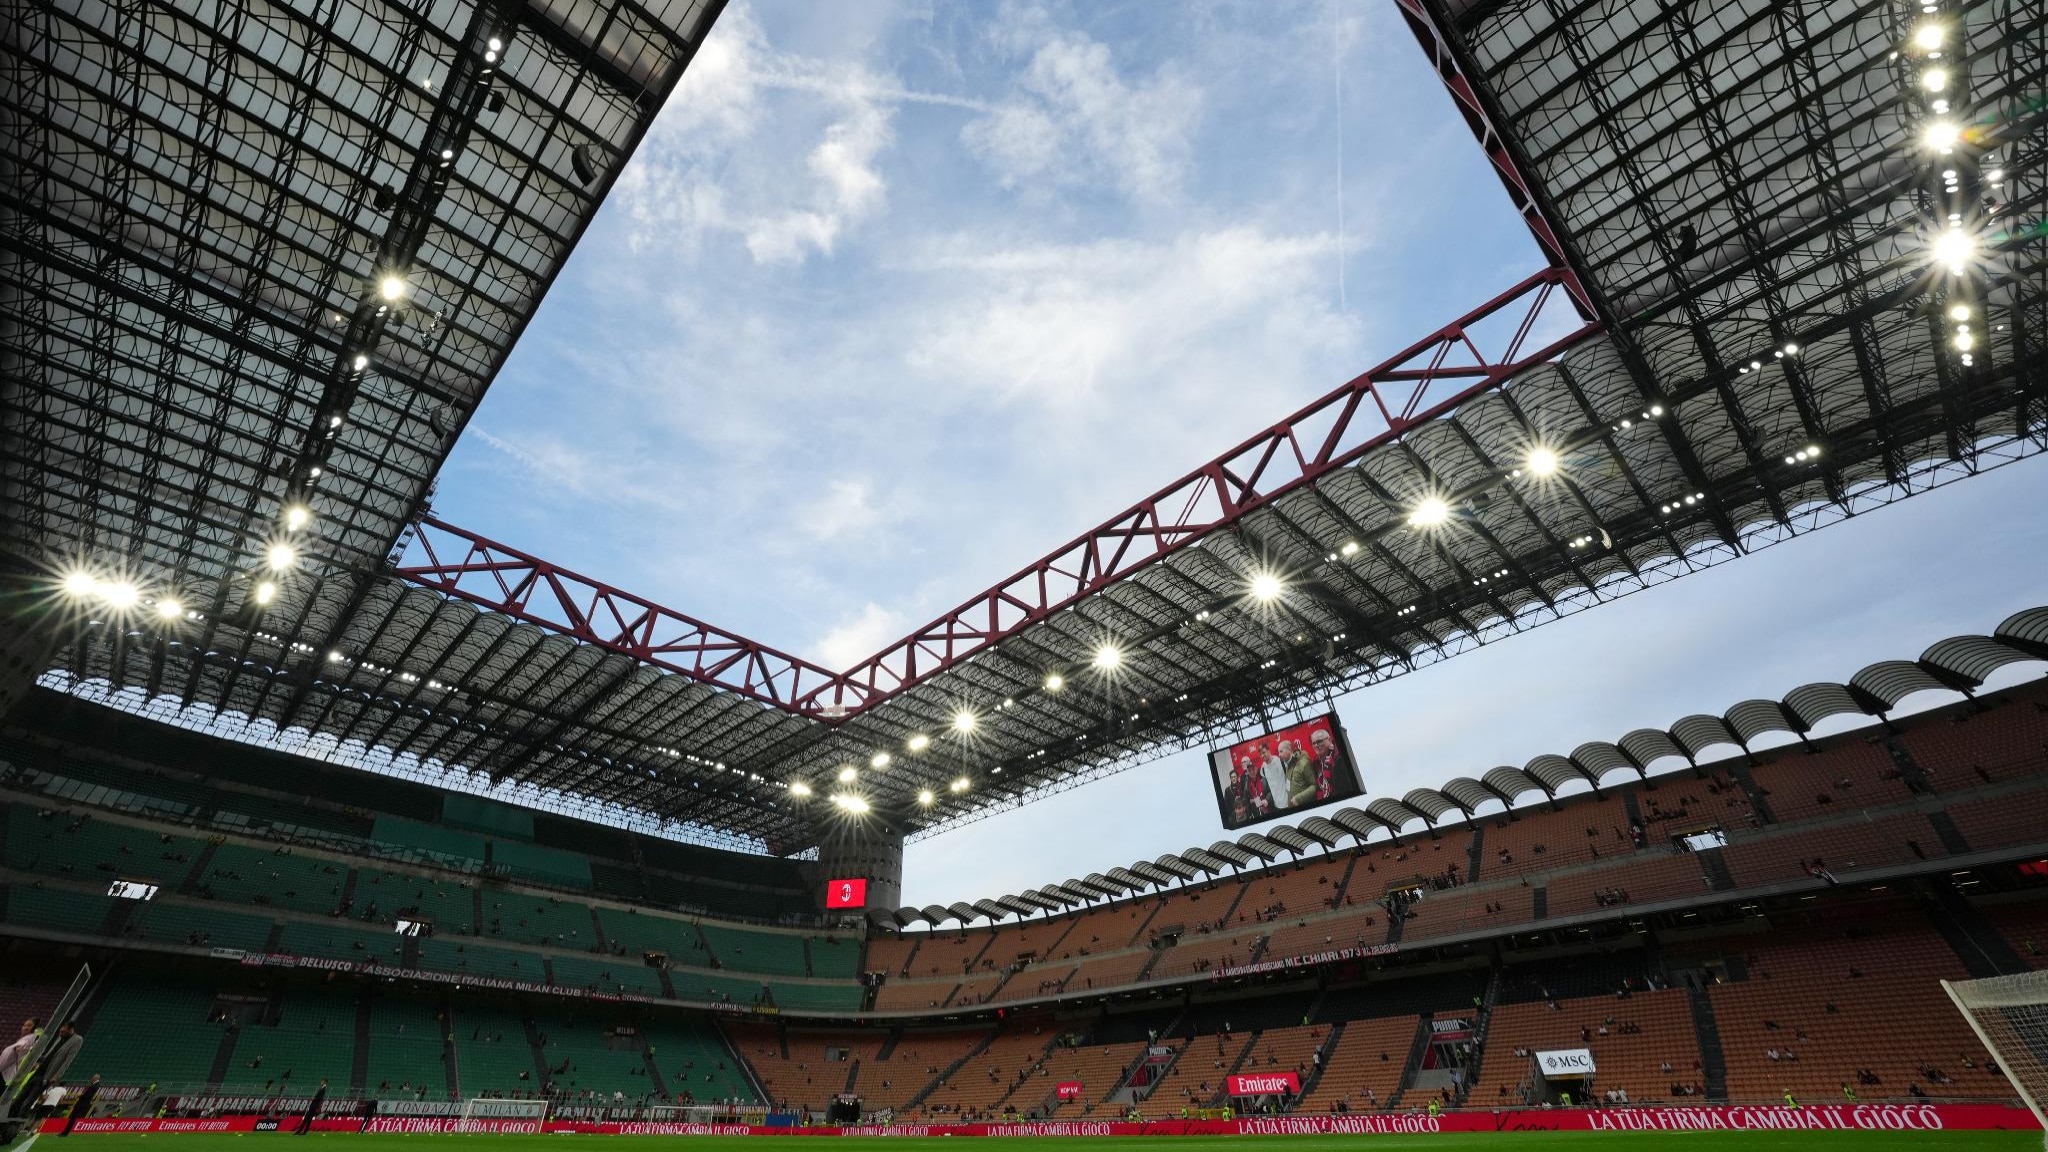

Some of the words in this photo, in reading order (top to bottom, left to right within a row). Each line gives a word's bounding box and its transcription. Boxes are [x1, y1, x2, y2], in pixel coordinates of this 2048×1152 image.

[1341, 948, 1360, 959] 1973
[300, 957, 352, 971] BELLUSCO
[364, 965, 458, 984] ASSOCIAZIONE
[461, 976, 513, 989] ITALIANA
[515, 982, 550, 994] MILAN
[552, 986, 581, 996] CLUB
[1432, 1019, 1460, 1032] PUMA
[1558, 1054, 1588, 1068] MSC
[1238, 1076, 1288, 1092] Emirates
[176, 1098, 212, 1110] MILAN
[216, 1098, 268, 1110] ACADEMY
[320, 1100, 358, 1112] CALCIO
[484, 1104, 521, 1115] MILAN
[556, 1106, 605, 1118] FAMILY
[611, 1108, 637, 1118] DAY
[158, 1121, 196, 1130] Emirates
[256, 1122, 278, 1130] 00:00
[1238, 1121, 1254, 1134] LA
[1256, 1120, 1278, 1134] TUA
[1281, 1120, 1318, 1134] FIRMA
[1322, 1119, 1376, 1134] CAMBIA
[1376, 1118, 1390, 1133] IL
[1392, 1117, 1440, 1133] GIOCO
[1588, 1114, 1612, 1130] LA
[1614, 1112, 1656, 1130] TUA
[1658, 1111, 1727, 1130] FIRMA
[1728, 1110, 1826, 1129] CAMBIA
[1824, 1110, 1854, 1129] IL
[1853, 1109, 1943, 1130] GIOCO
[74, 1122, 116, 1131] Emirates
[380, 1121, 402, 1133] TUA
[404, 1122, 441, 1133] FIRMA
[444, 1122, 488, 1133] CAMBIA
[501, 1122, 536, 1134] GIOCO
[652, 1124, 678, 1135] FIRMA
[680, 1124, 712, 1135] CAMBIA
[724, 1126, 750, 1136] GIOCO
[988, 1126, 998, 1136] LA
[998, 1126, 1012, 1136] TUA
[1014, 1126, 1038, 1136] FIRMA
[1039, 1125, 1072, 1136] CAMBIA
[1072, 1124, 1080, 1136] IL
[1082, 1124, 1110, 1136] GIOCO
